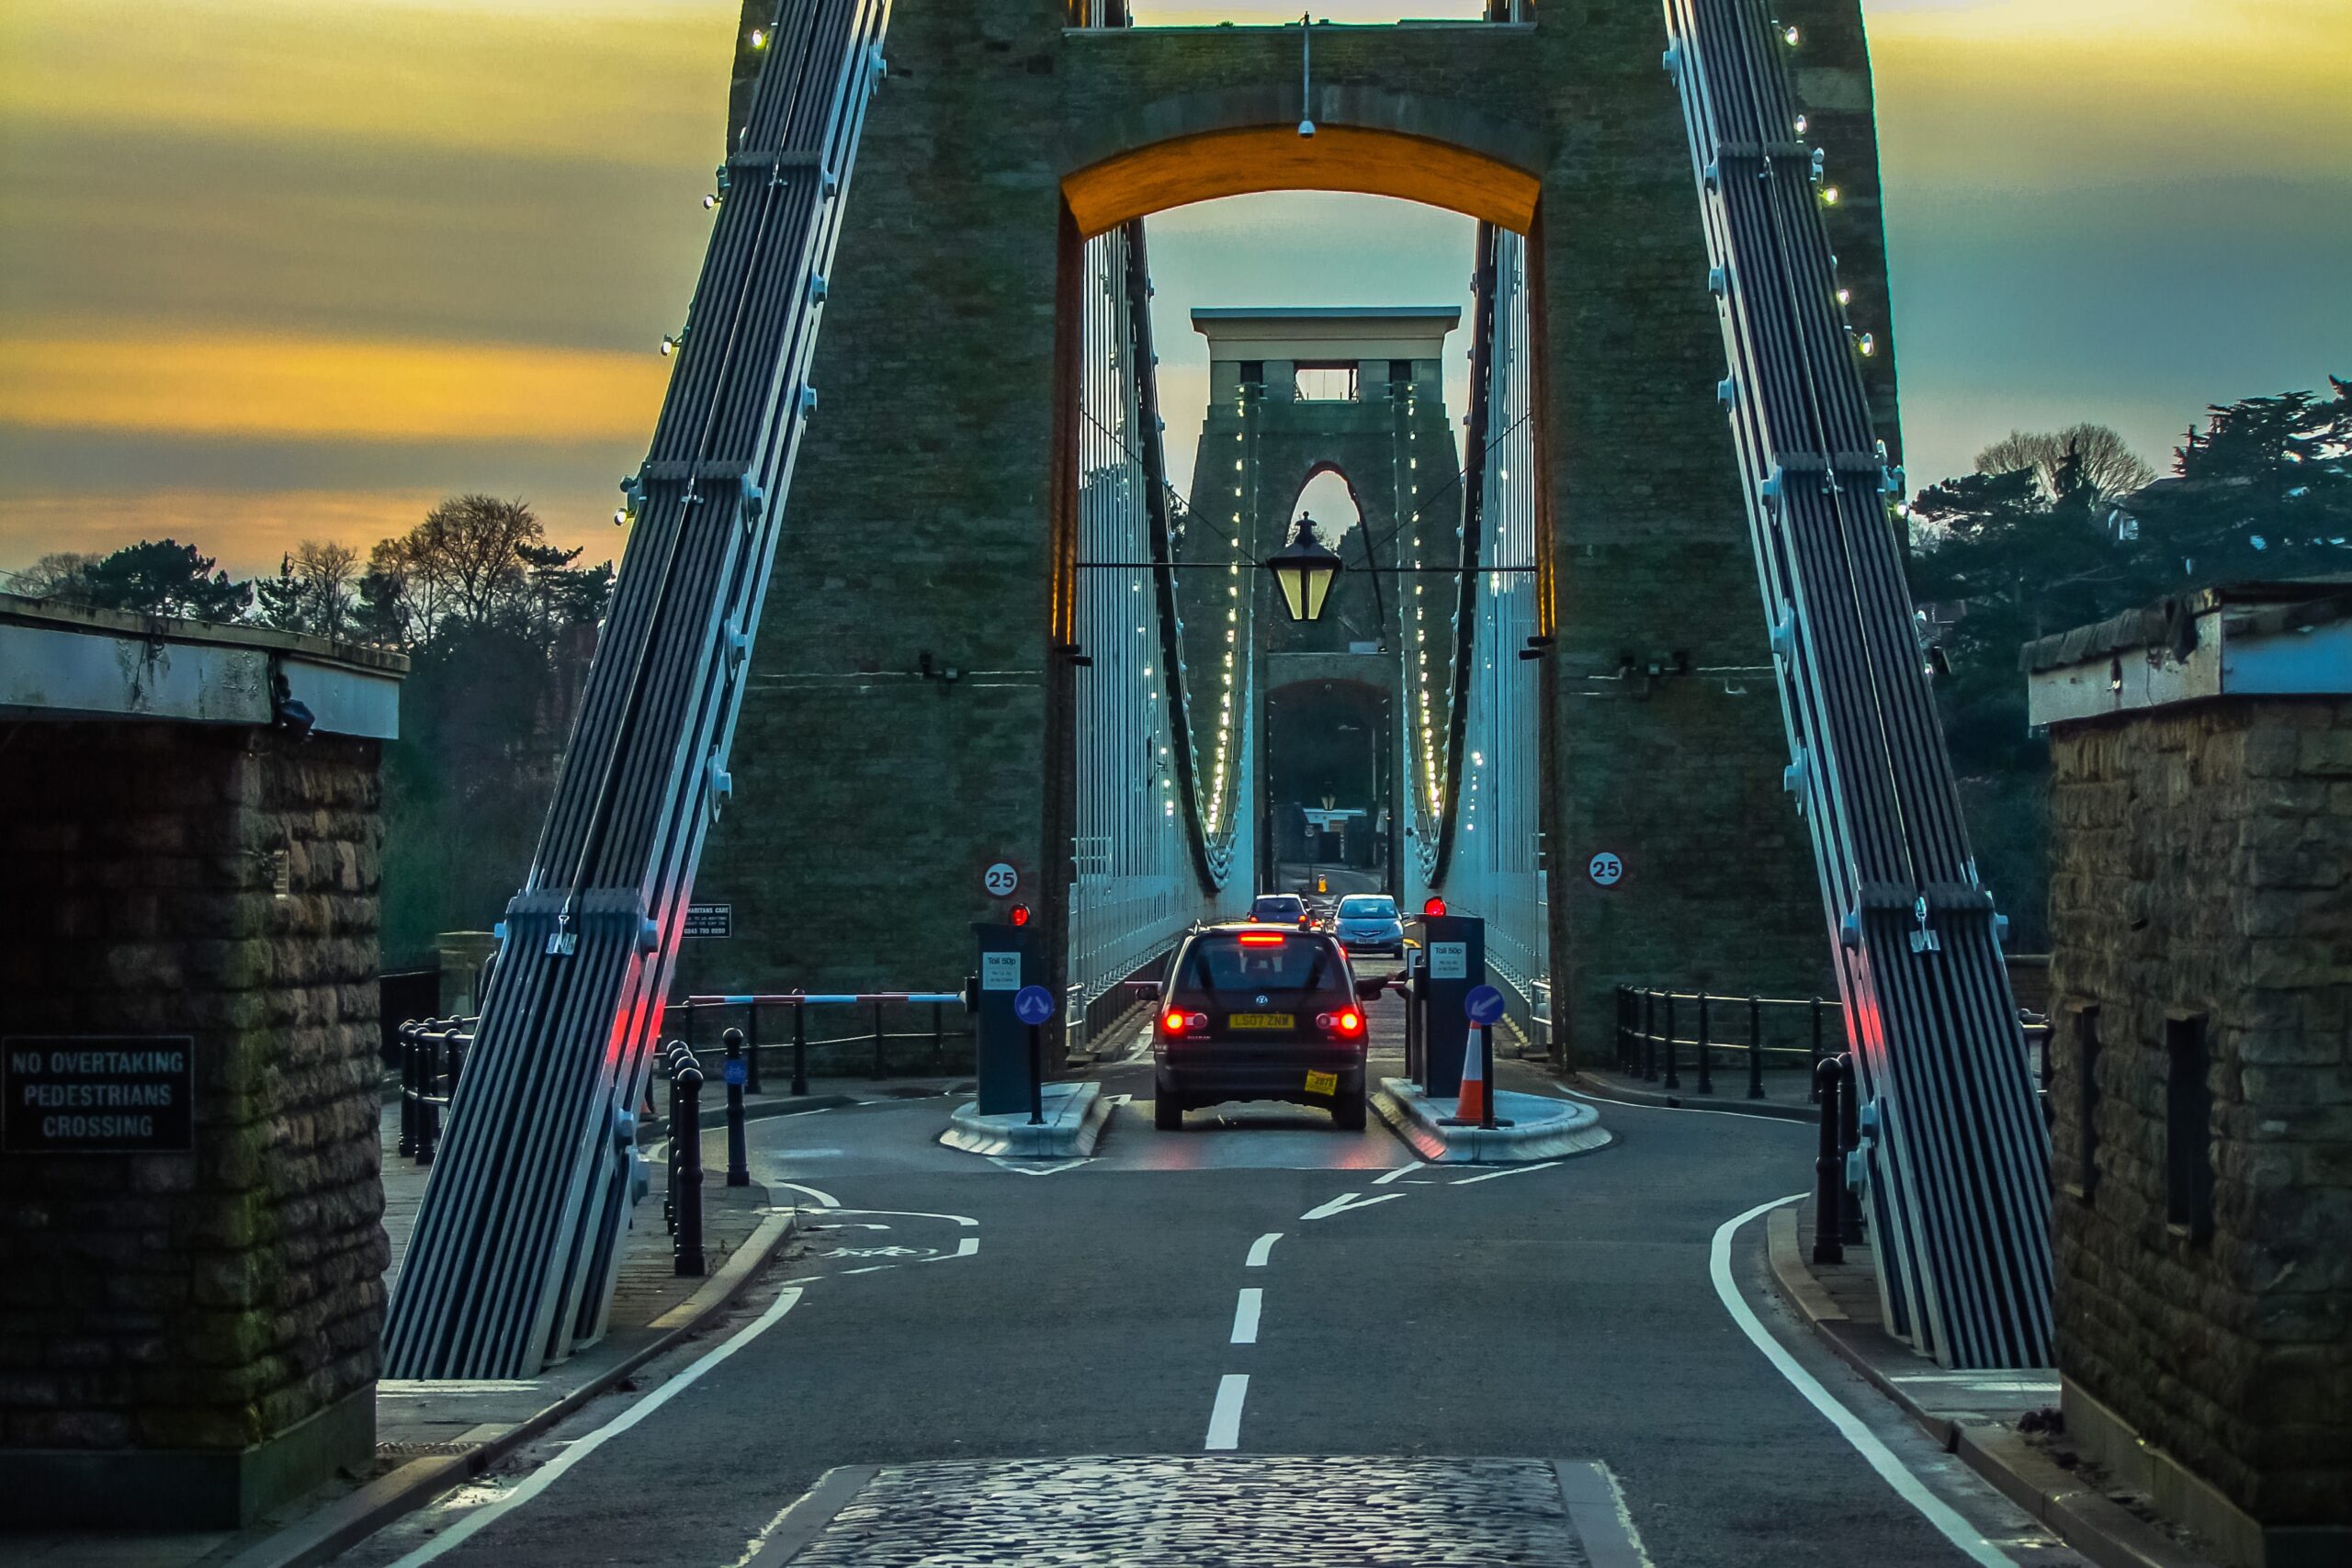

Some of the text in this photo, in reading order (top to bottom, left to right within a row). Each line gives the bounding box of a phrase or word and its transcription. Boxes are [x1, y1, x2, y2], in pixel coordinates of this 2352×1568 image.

[1593, 861, 1619, 877] 25
[989, 872, 1014, 888] 25
[1448, 947, 1463, 956] 50p
[988, 956, 1016, 966] Toll 50p
[12, 1052, 184, 1073] NO OVERTAKING
[24, 1085, 172, 1106] PEDESTRIANS
[43, 1115, 153, 1137] CROSSING
